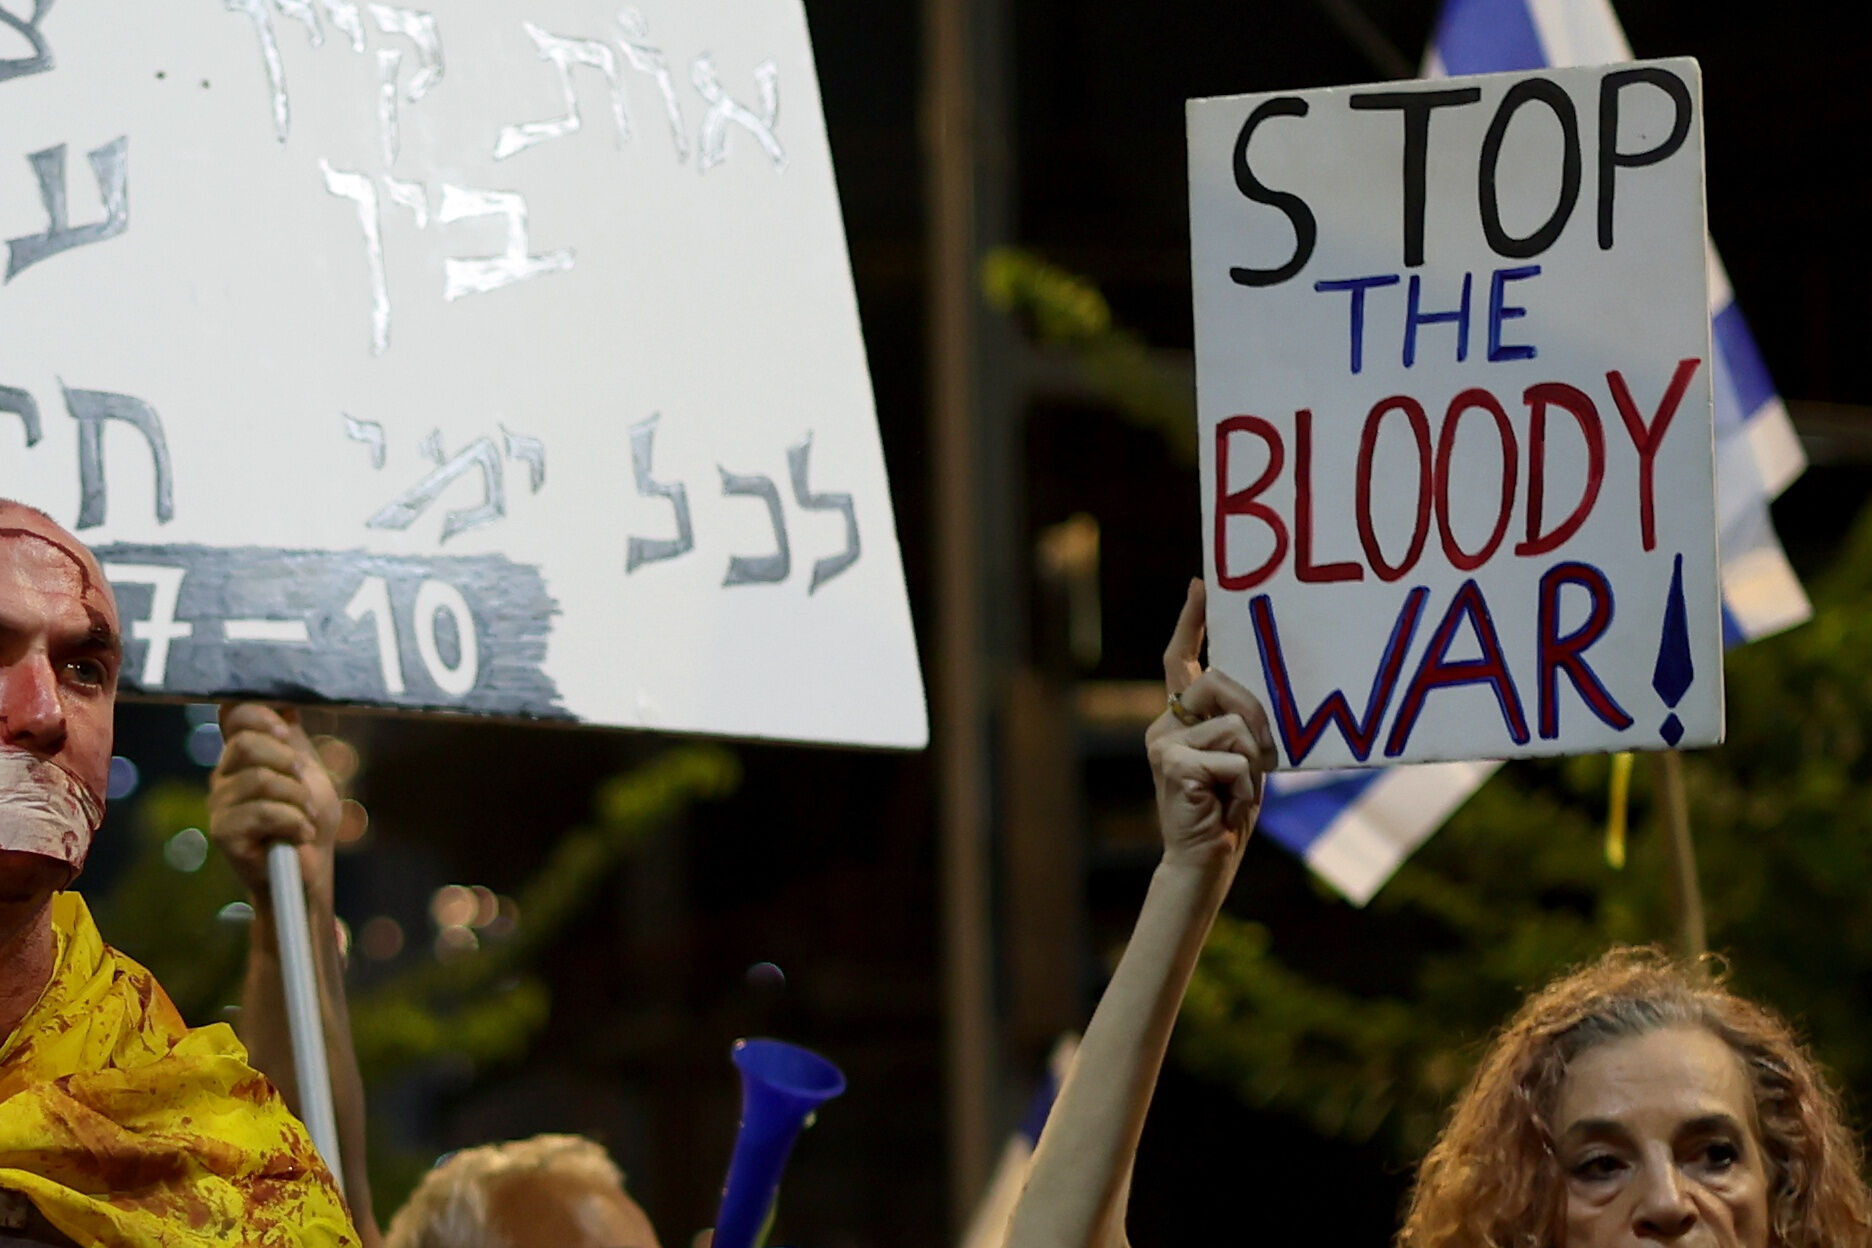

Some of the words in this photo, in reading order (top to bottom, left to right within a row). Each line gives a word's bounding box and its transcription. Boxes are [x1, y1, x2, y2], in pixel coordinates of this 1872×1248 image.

[317, 156, 576, 356] בין
[1228, 67, 1693, 287] STOP
[1313, 264, 1542, 374] THE
[342, 411, 547, 545] ימי
[624, 411, 863, 597] לכל
[1213, 357, 1701, 592] BLOODY
[1248, 552, 1694, 766] WAR!
